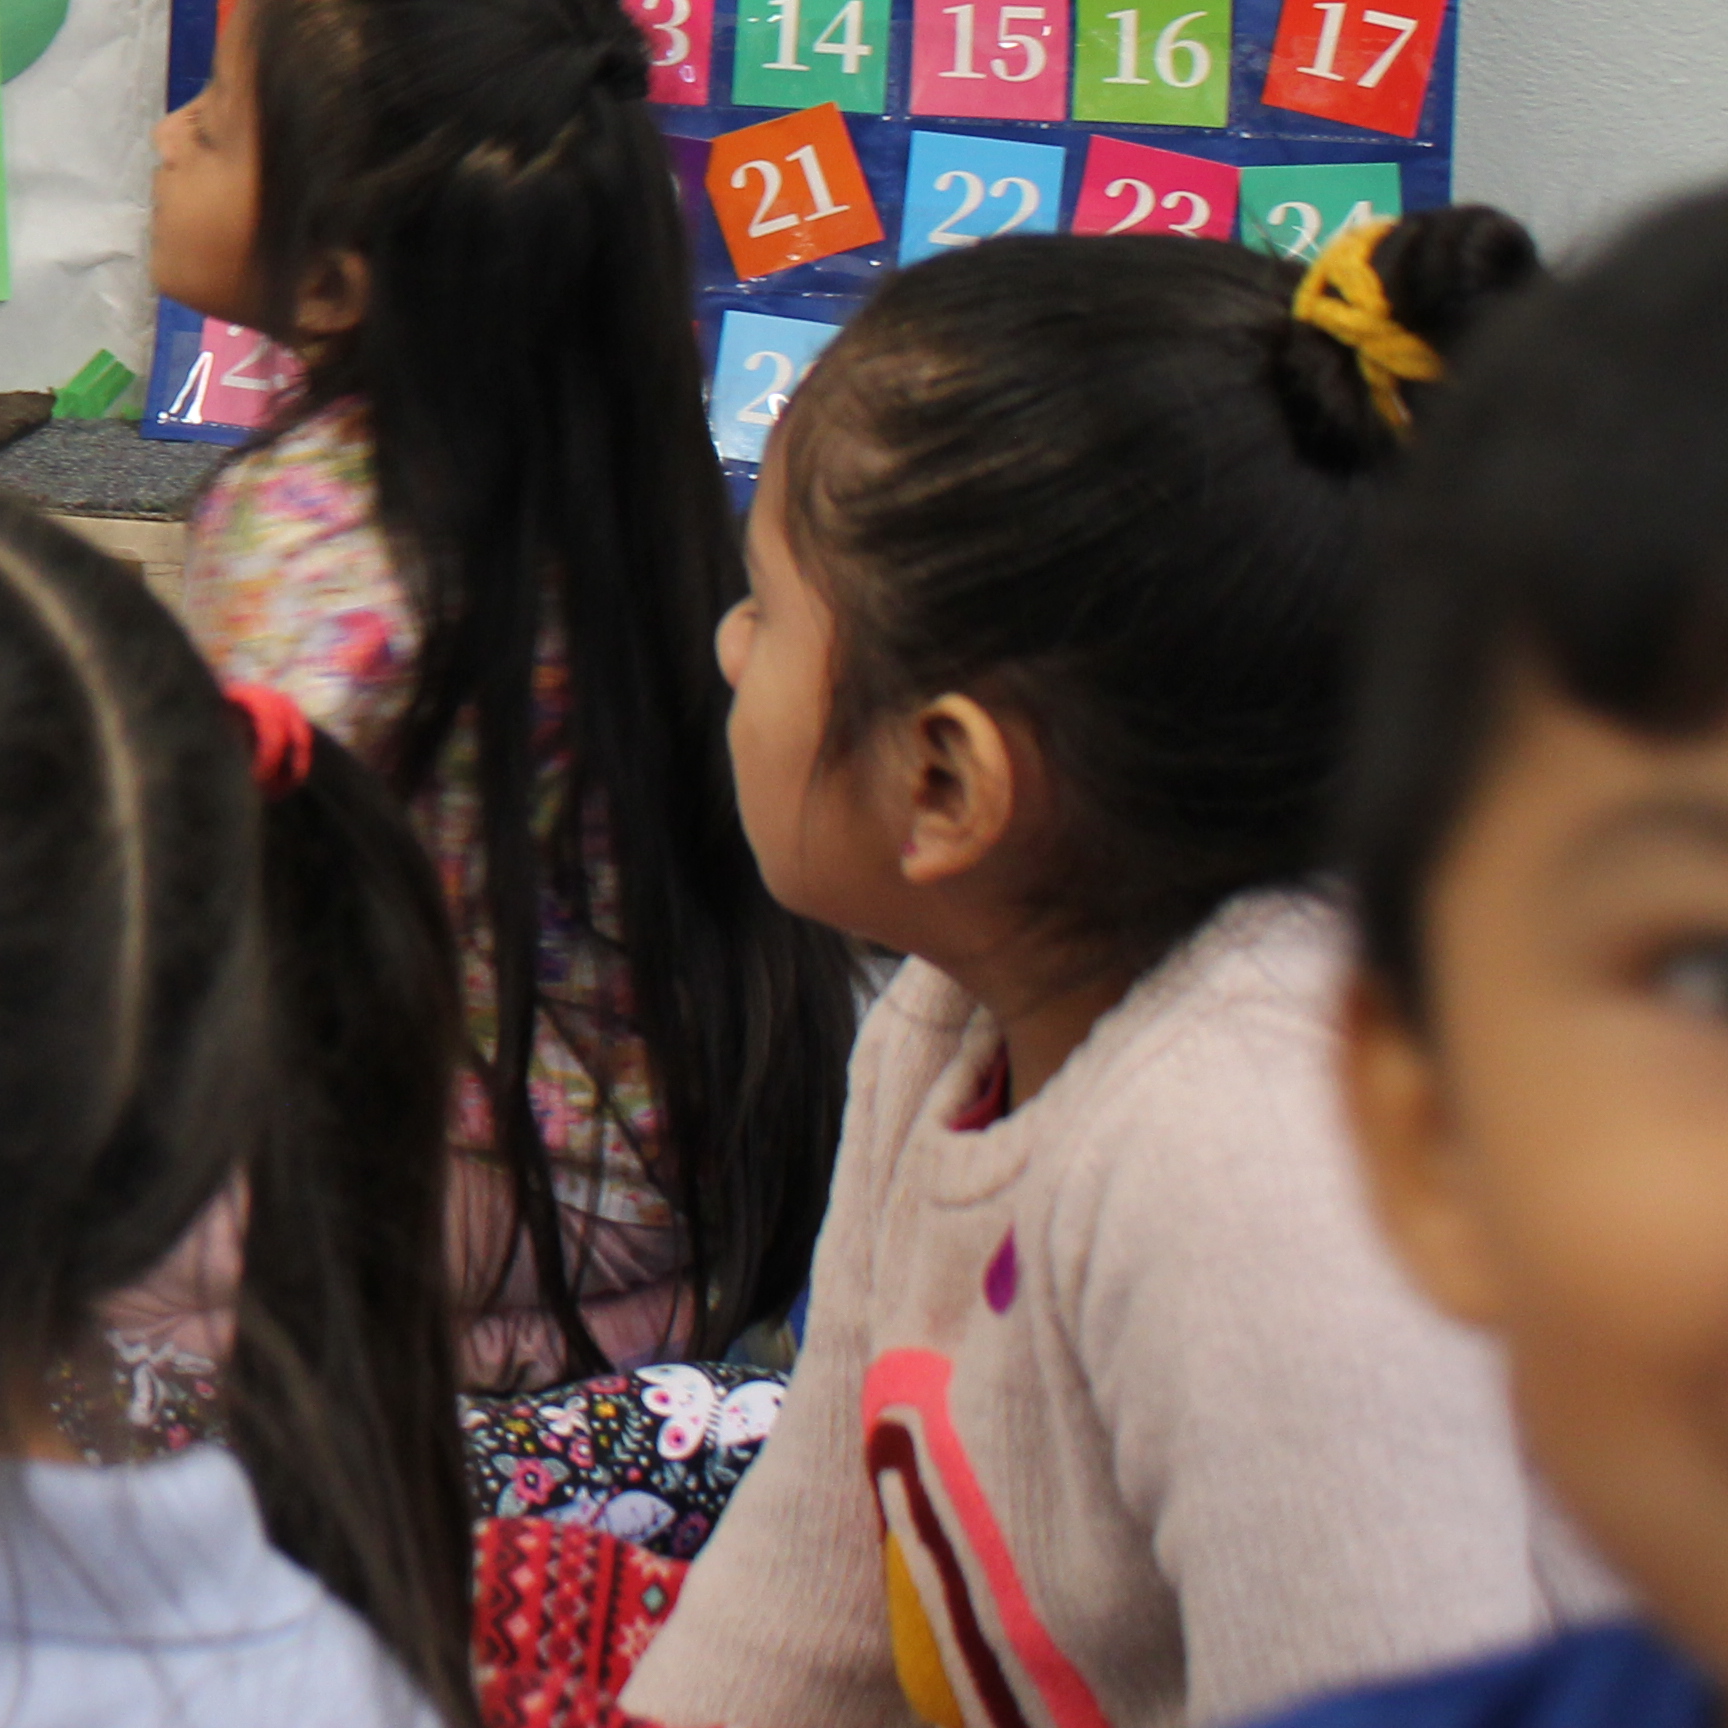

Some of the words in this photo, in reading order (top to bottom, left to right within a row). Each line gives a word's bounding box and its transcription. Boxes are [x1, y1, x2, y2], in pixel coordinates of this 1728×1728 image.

[939, 2, 1049, 83] 15
[1102, 9, 1213, 89] 16
[1295, 0, 1419, 89] 17
[730, 144, 851, 239] 21
[928, 170, 1040, 248] 22
[736, 351, 818, 426] 2
